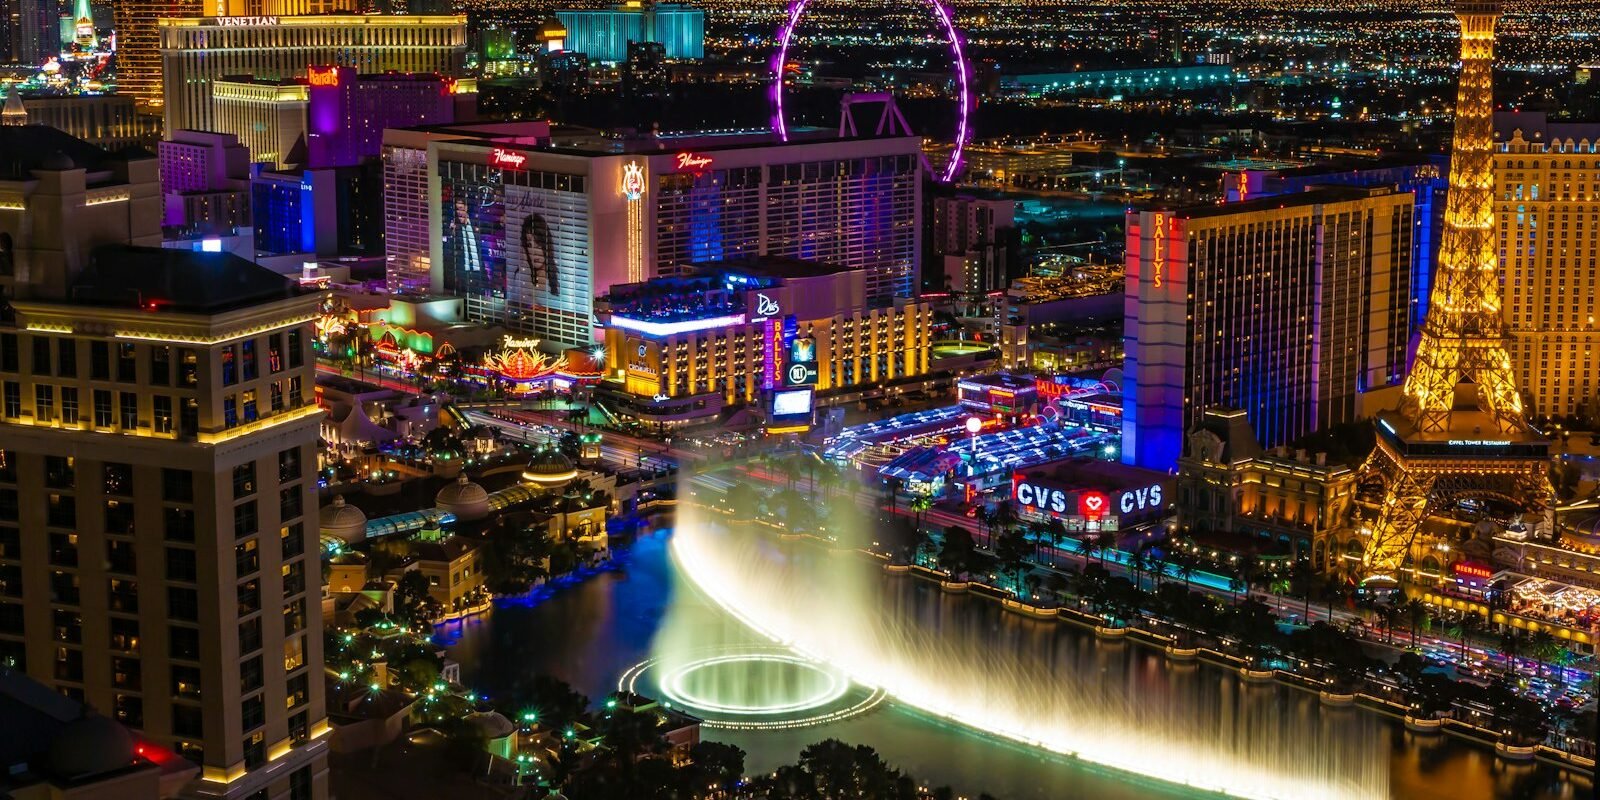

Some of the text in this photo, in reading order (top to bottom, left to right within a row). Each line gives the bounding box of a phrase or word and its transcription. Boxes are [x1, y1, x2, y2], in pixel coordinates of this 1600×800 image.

[217, 17, 277, 26] VENETIAN
[494, 149, 526, 167] Flamingo
[504, 335, 540, 351] Flamingo
[1037, 379, 1071, 396] BALLY'S
[1018, 483, 1066, 513] CVS
[1120, 484, 1162, 513] CVS
[1474, 568, 1491, 577] PARK
